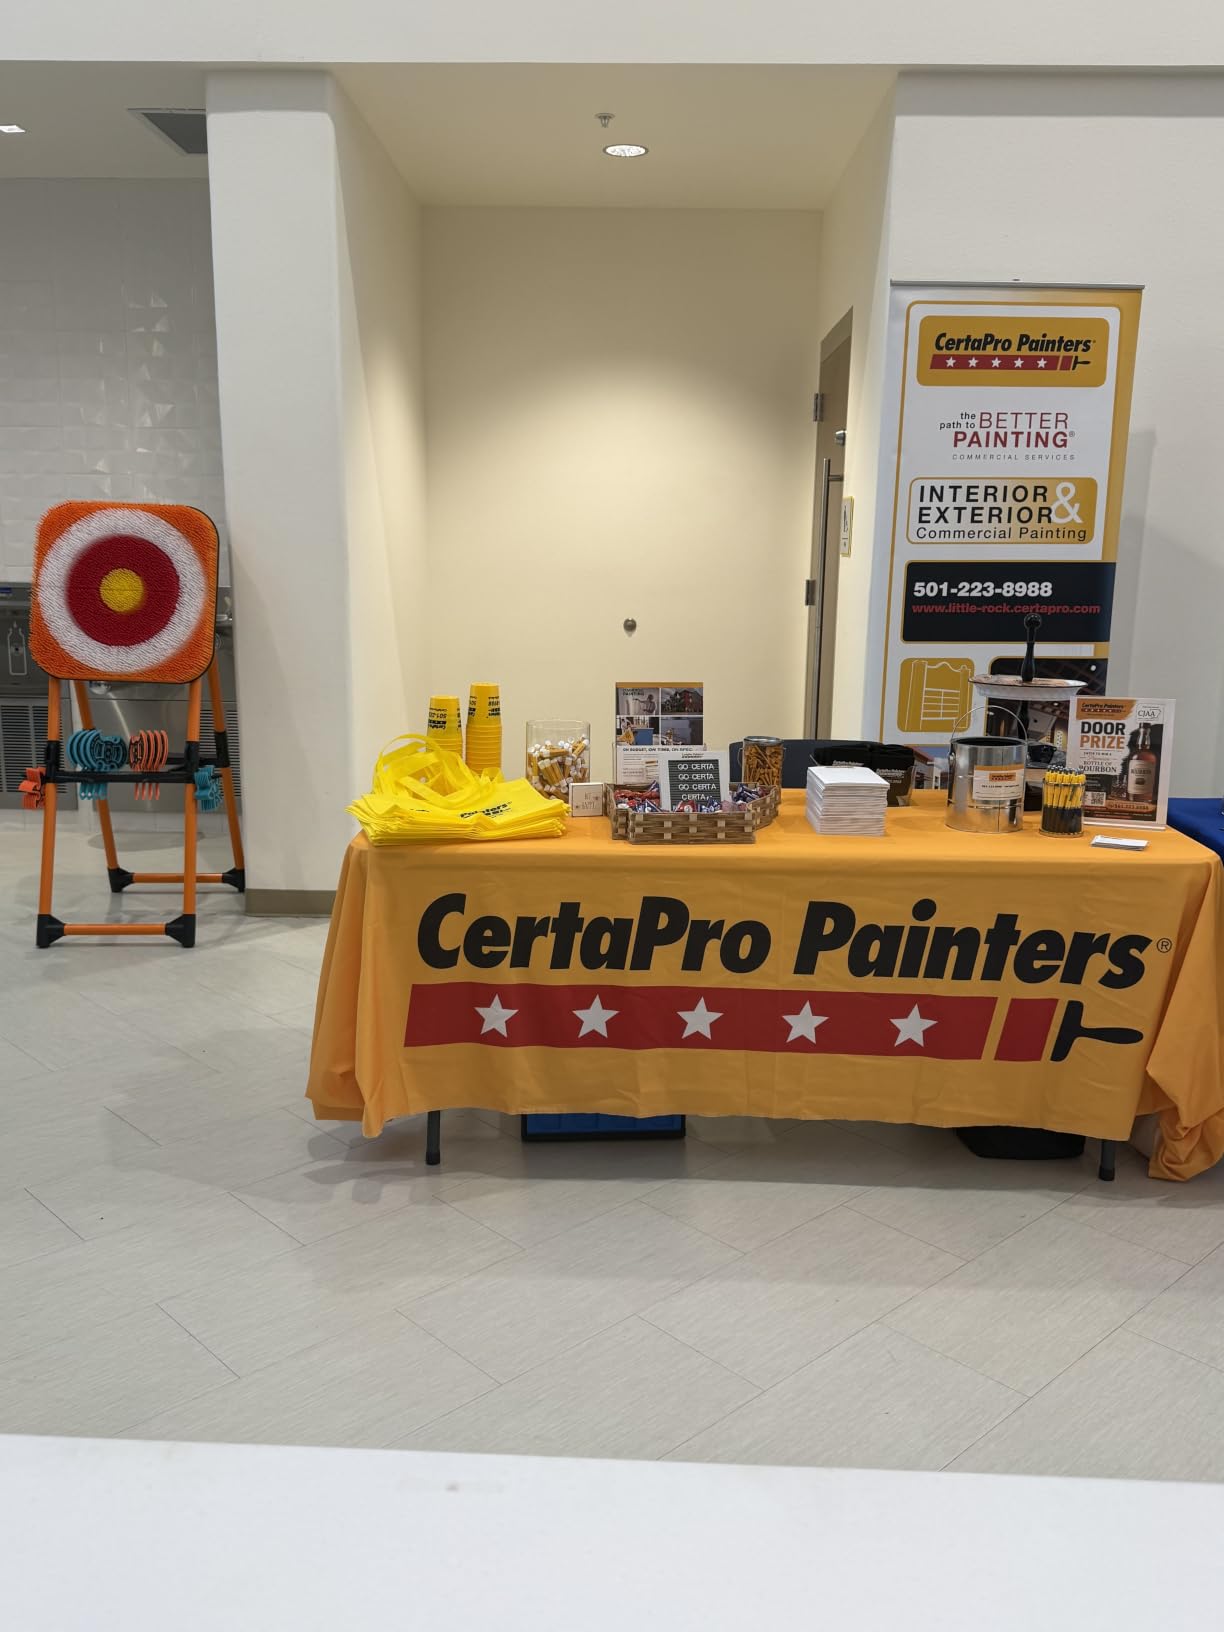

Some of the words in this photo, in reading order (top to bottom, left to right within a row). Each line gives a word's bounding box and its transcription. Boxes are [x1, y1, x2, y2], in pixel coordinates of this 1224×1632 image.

[934, 332, 1012, 352] CertaPro
[1016, 333, 1092, 353] Painters
[960, 412, 976, 420] the
[979, 411, 1069, 430] BETTER
[939, 421, 962, 431] path
[965, 421, 976, 429] to
[952, 453, 1019, 461] COMMERCIAL
[919, 485, 1048, 503] INTERIOR
[918, 506, 1053, 524] EXTERIOR
[1050, 481, 1084, 524] &
[916, 526, 1012, 539] Commercial
[1019, 526, 1087, 542] Painting
[913, 581, 1053, 597] 501-223-8988
[911, 602, 1101, 616] www.little-rock.certapro.com
[1080, 721, 1126, 736] DOOR
[1079, 735, 1126, 750] PRIZE
[677, 763, 689, 771] GO
[691, 763, 715, 771] CERTA
[678, 783, 690, 791] GO
[417, 892, 772, 974] CertaPro
